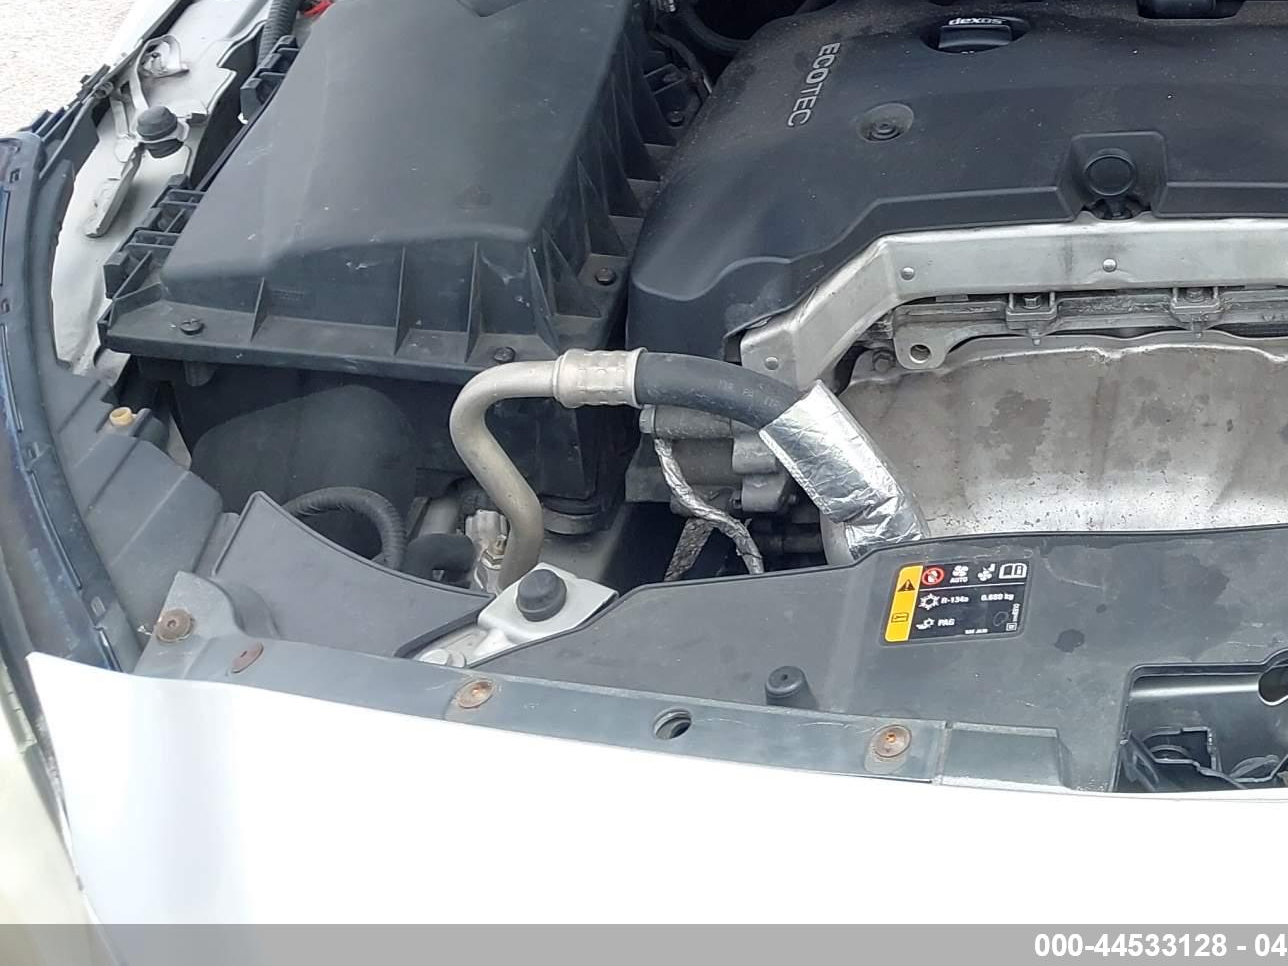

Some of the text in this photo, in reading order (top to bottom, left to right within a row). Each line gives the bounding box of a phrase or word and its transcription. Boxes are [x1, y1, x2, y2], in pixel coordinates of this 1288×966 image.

[948, 17, 1003, 25] dexos
[788, 42, 841, 126] ECOTEC
[941, 595, 969, 604] R-134a
[938, 618, 955, 626] PAG
